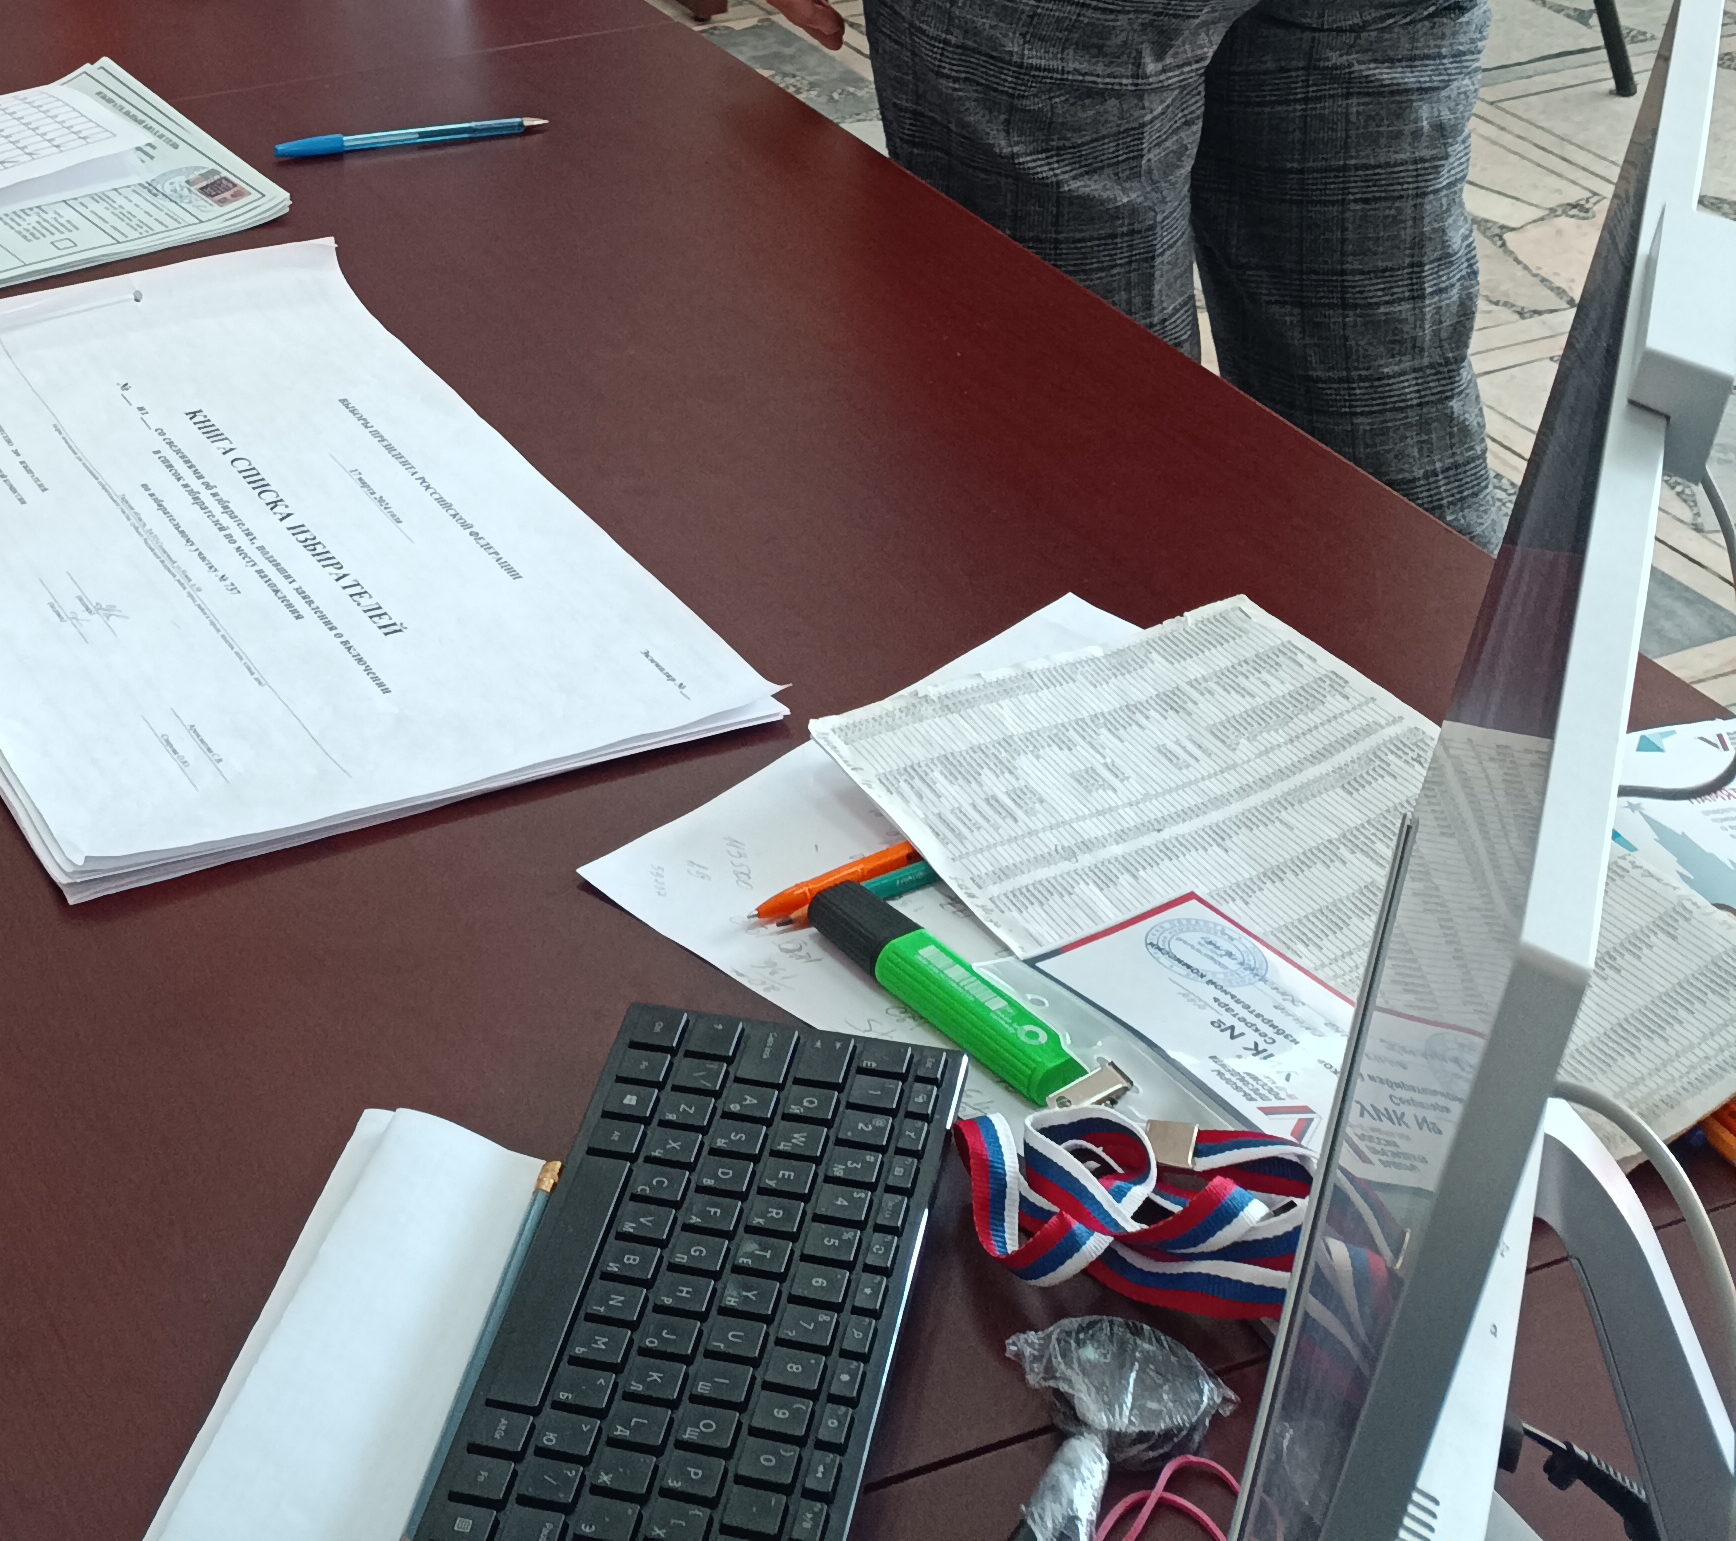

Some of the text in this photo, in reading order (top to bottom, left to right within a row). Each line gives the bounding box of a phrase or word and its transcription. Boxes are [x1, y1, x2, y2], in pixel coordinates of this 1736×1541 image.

[337, 398, 522, 580] ВЫБОРЫ ПРЕЗИДЕНТА РОССИЙСКОЙ ФЕДЕРАЦИИ
[184, 408, 407, 636] КНИГА СПИСКА ИЗБИРАТЕЛЕЙ
[1144, 939, 1206, 979] комиссии
[1204, 978, 1299, 1045] избирательной
[1212, 996, 1276, 1044] Секретарь
[1209, 1018, 1245, 1040] №
[803, 1097, 817, 1107] Q
[857, 1122, 872, 1131] 2
[789, 1132, 806, 1145] W
[846, 1160, 861, 1168] 3
[778, 1170, 794, 1179] E
[835, 1197, 848, 1205] 4
[766, 1207, 782, 1218] R
[591, 1103, 694, 1349] Z X C V B N M
[823, 1237, 838, 1246] 5
[754, 1246, 771, 1258] T
[630, 1094, 757, 1426] A S D F G H J K L
[811, 1277, 826, 1286] 6
[740, 1290, 757, 1300] Y
[799, 1320, 814, 1329] 7
[727, 1331, 744, 1342] U
[786, 1363, 801, 1372] 8
[773, 1408, 788, 1418] 9
[697, 1419, 715, 1432] O
[760, 1454, 775, 1465] 0
[686, 1466, 702, 1479] P
